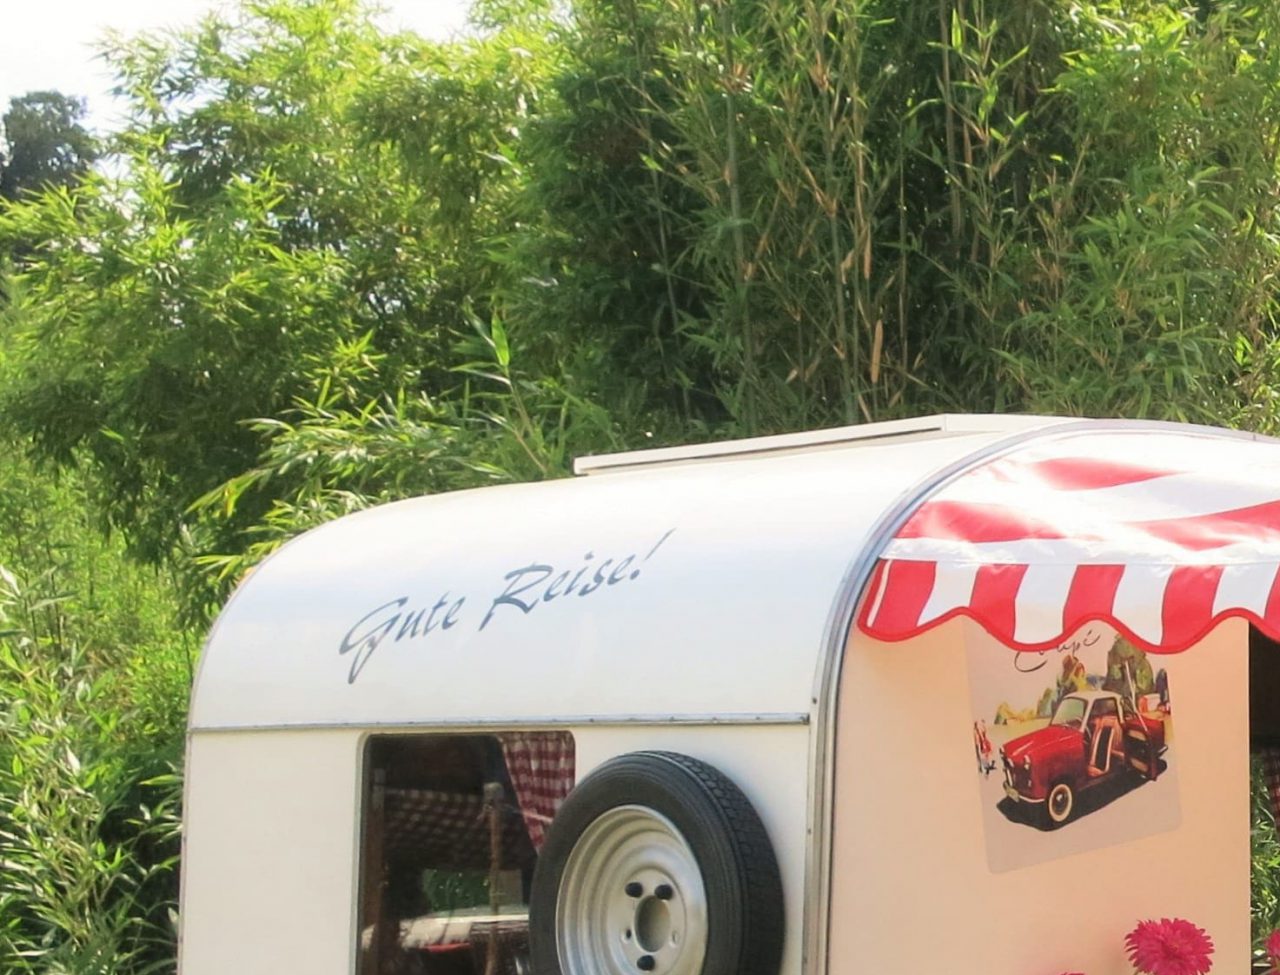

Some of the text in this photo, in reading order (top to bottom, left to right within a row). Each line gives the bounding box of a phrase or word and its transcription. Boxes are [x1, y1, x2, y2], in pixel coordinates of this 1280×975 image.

[339, 528, 677, 684] Gute Reise!
[1014, 629, 1101, 673] Cupé
